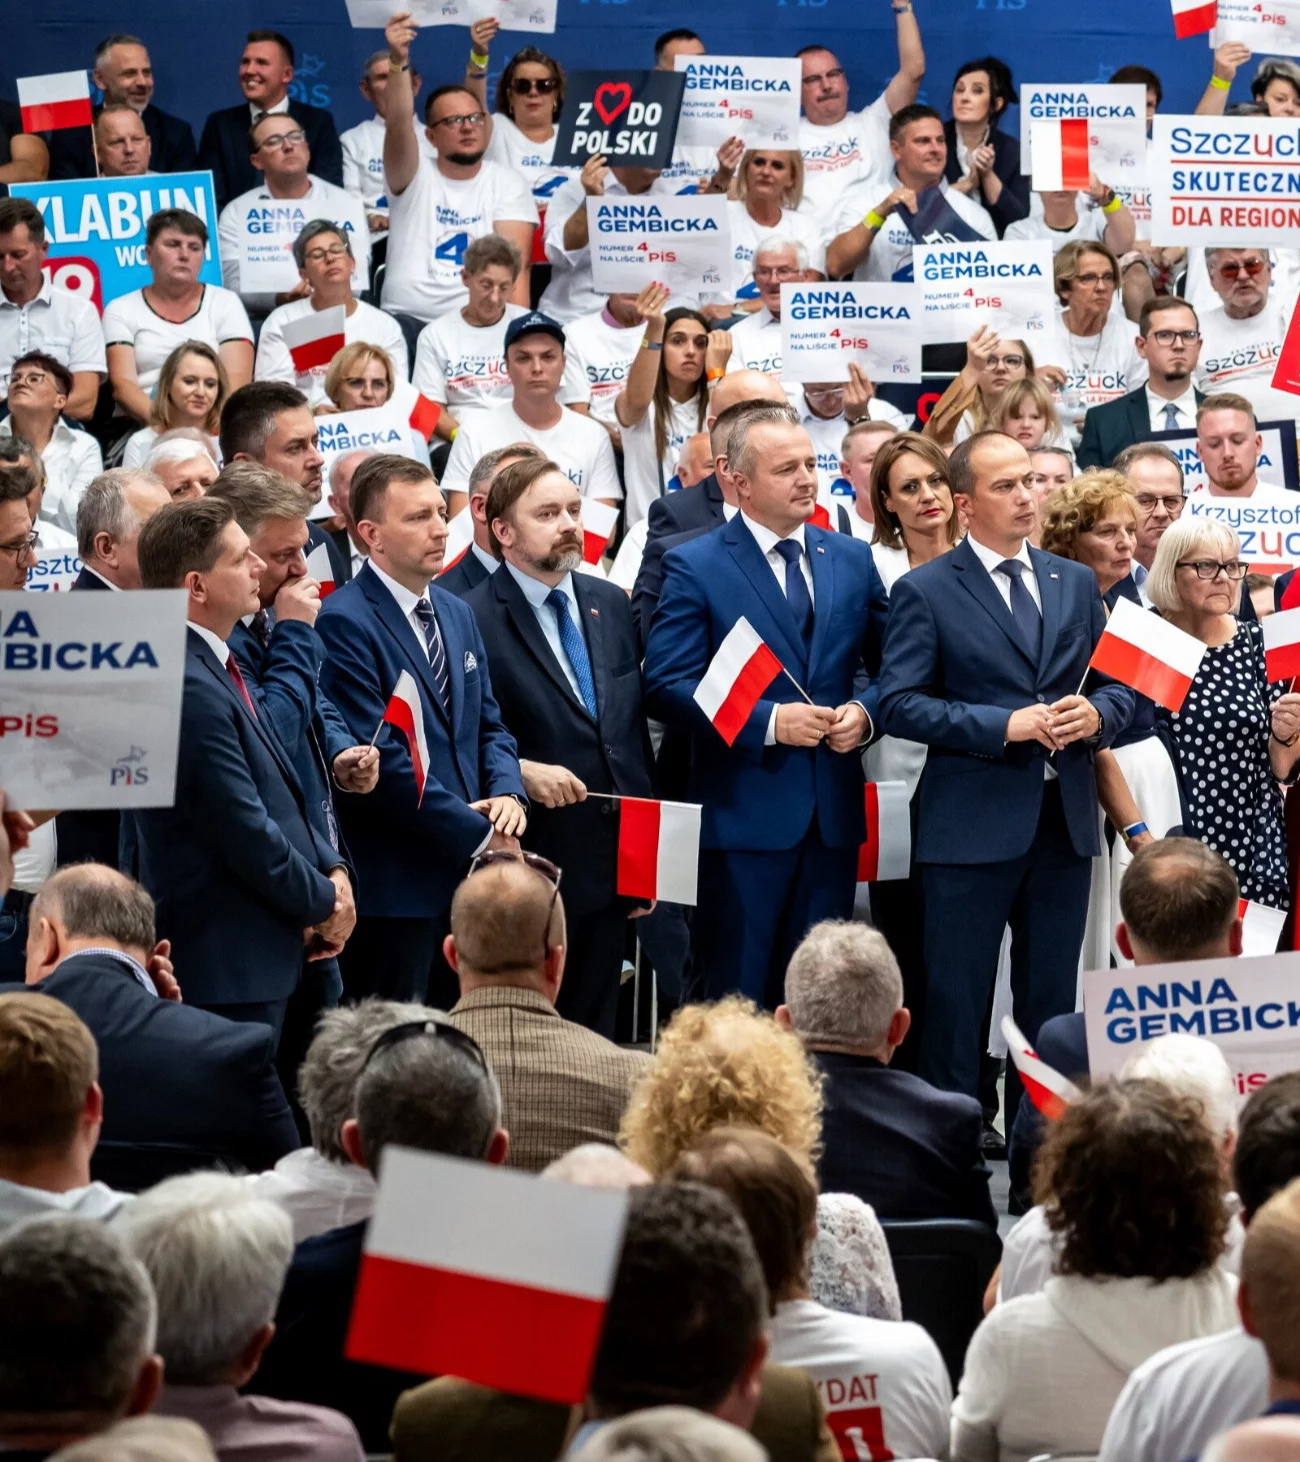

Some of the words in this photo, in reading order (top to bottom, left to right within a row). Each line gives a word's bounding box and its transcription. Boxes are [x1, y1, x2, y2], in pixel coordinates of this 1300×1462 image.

[1253, 4, 1264, 13] 4
[1261, 14, 1287, 26] PiS
[685, 63, 744, 77] ANNA
[685, 77, 791, 92] GEMBICKA
[718, 99, 729, 108] 4
[1030, 92, 1089, 104] ANNA
[576, 102, 594, 126] Z
[626, 102, 662, 127] DO
[728, 109, 754, 120] PiS
[1030, 106, 1136, 118] GEMBICKA
[570, 131, 658, 156] POLSKI
[247, 208, 304, 220] ANNA
[597, 205, 662, 218] ANNA
[1172, 206, 1212, 227] DLA
[598, 218, 718, 233] GEMBICKA
[435, 232, 468, 265] 4
[637, 242, 648, 252] 4
[648, 250, 677, 263] PiS
[924, 250, 988, 266] ANNA
[924, 263, 1043, 281] GEMBICKA
[791, 291, 856, 305] ANNA
[924, 292, 960, 300] NUMER
[963, 288, 975, 297] 4
[975, 296, 1002, 309] PiS
[791, 305, 911, 320] GEMBICKA
[830, 328, 841, 338] 4
[841, 338, 869, 350] PiS
[320, 428, 402, 453] MBICKA
[4, 642, 160, 672] BICKA
[0, 713, 59, 739] PiS
[110, 766, 149, 787] PiS
[1104, 978, 1238, 1015] ANNA
[1237, 1072, 1268, 1097] iS
